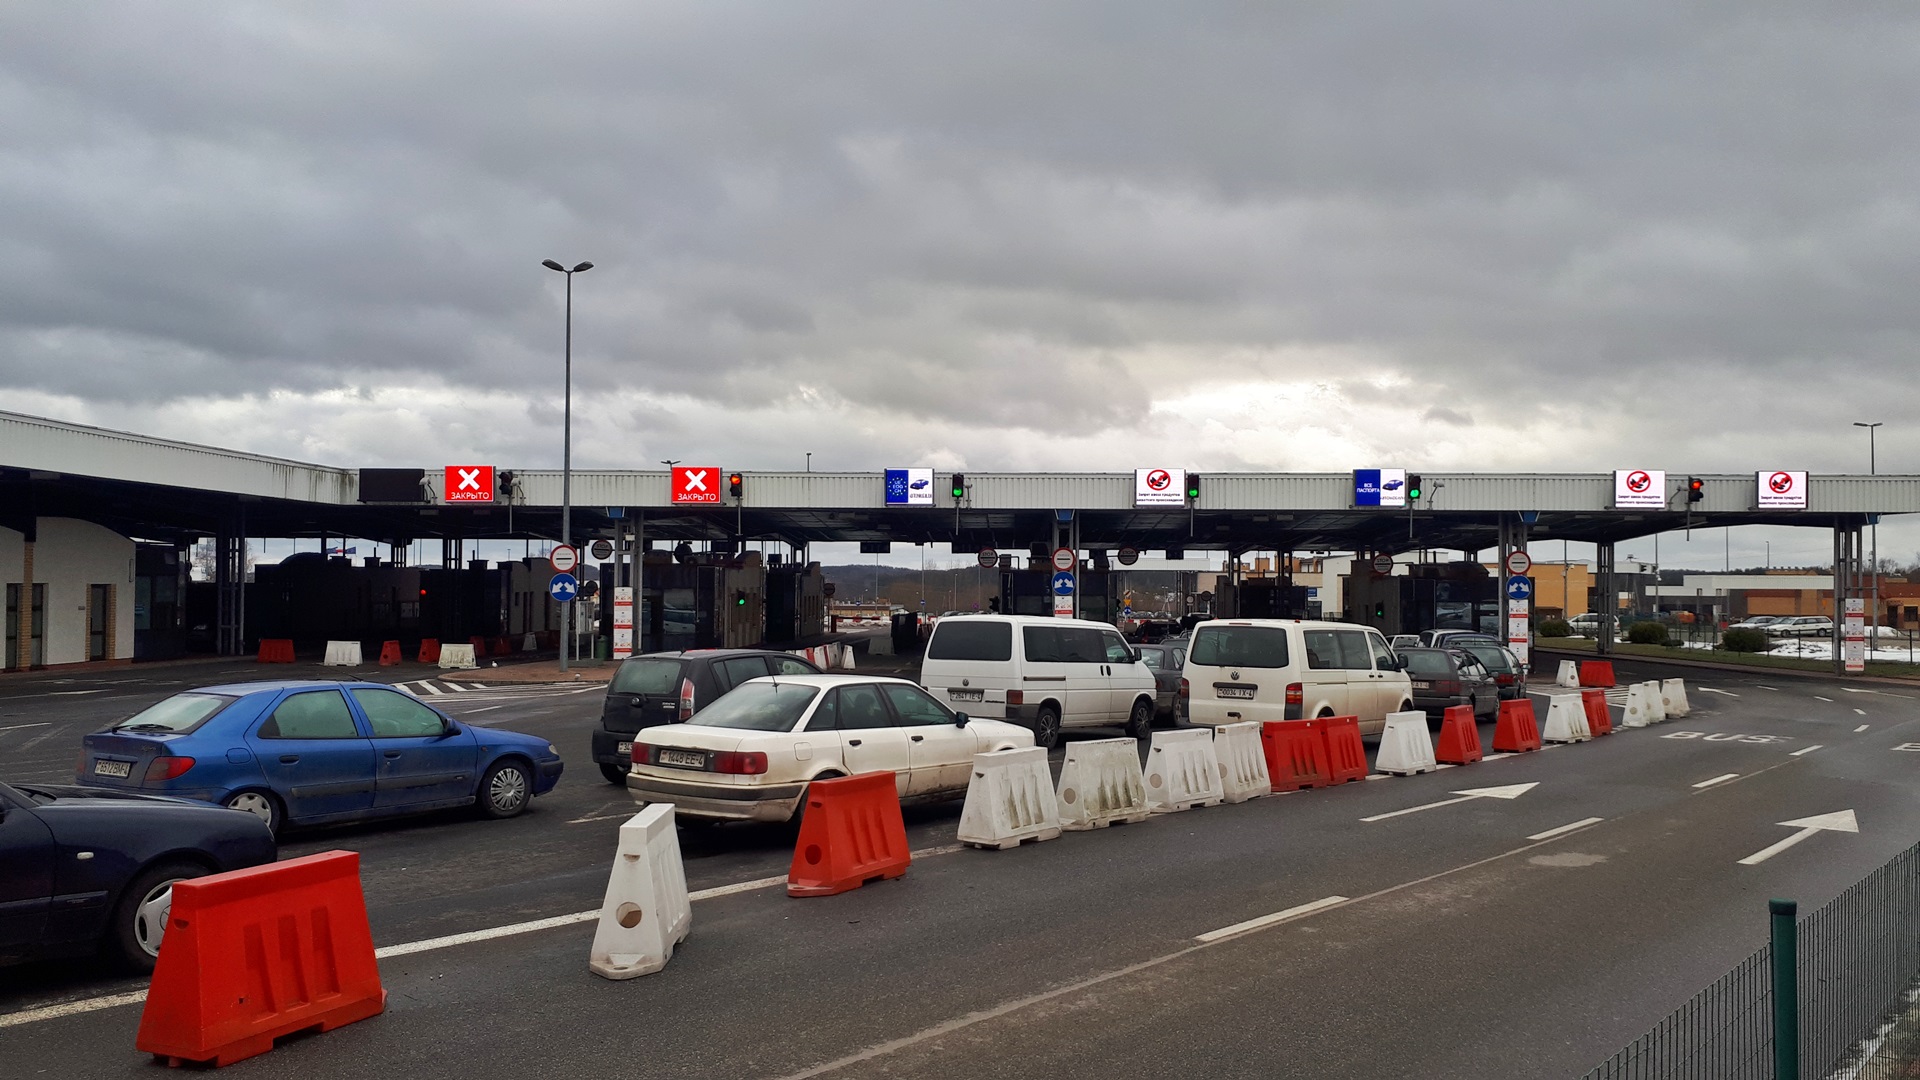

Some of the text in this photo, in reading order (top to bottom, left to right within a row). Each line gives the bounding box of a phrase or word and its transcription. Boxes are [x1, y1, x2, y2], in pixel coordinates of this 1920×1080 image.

[1660, 731, 1782, 743] BUS
[668, 751, 703, 766] 1448 EE-4
